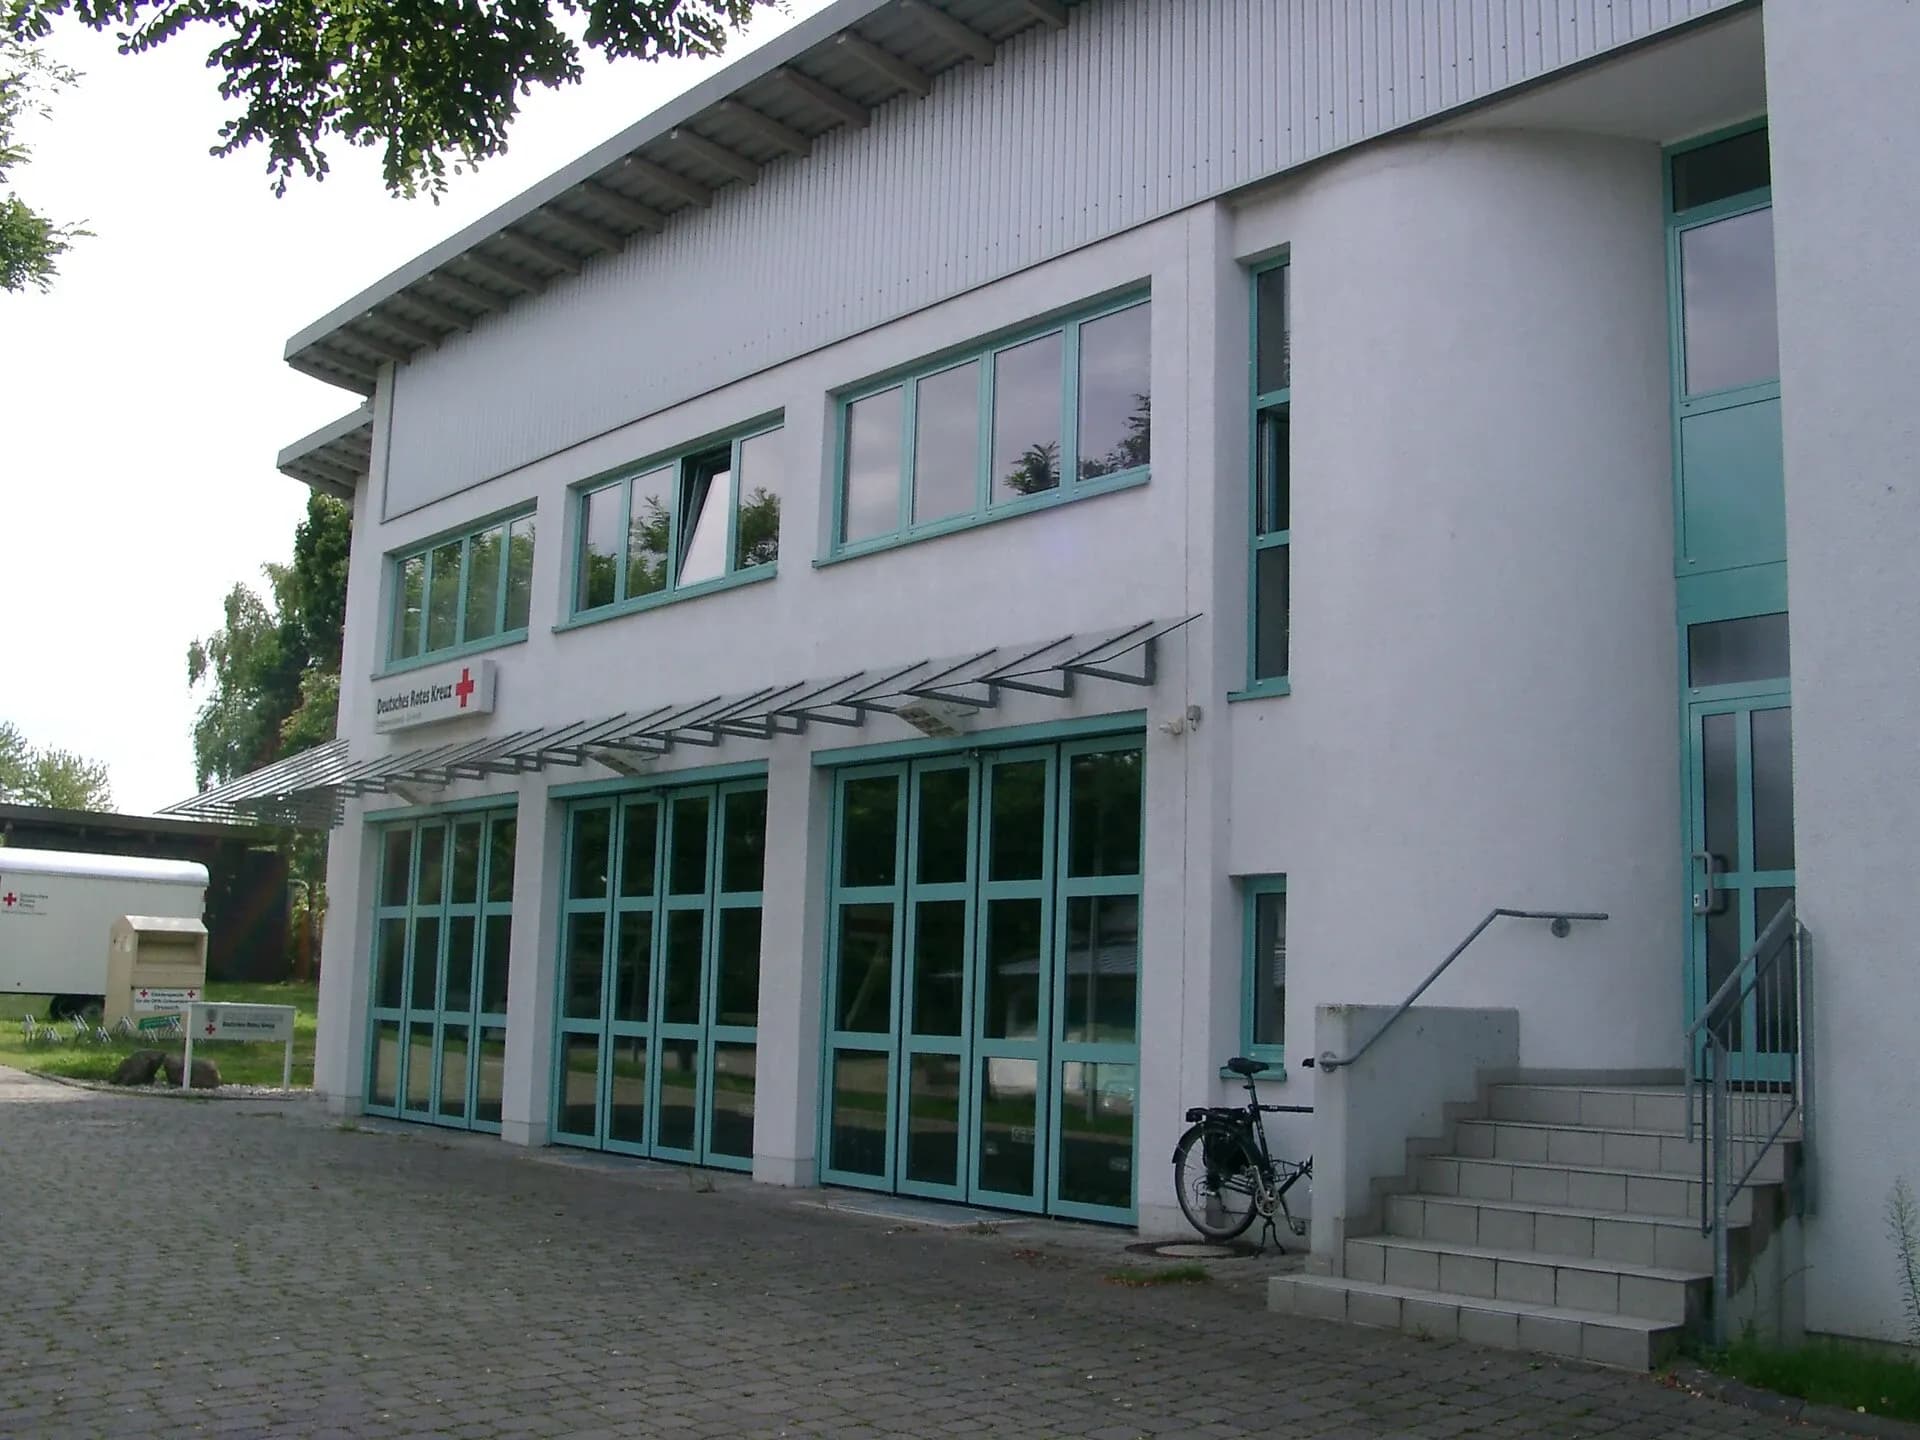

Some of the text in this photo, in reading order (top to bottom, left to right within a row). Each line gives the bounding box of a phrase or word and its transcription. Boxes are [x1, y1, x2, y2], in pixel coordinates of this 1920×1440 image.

[377, 684, 453, 714] Deutsches Rotes Kreuz
